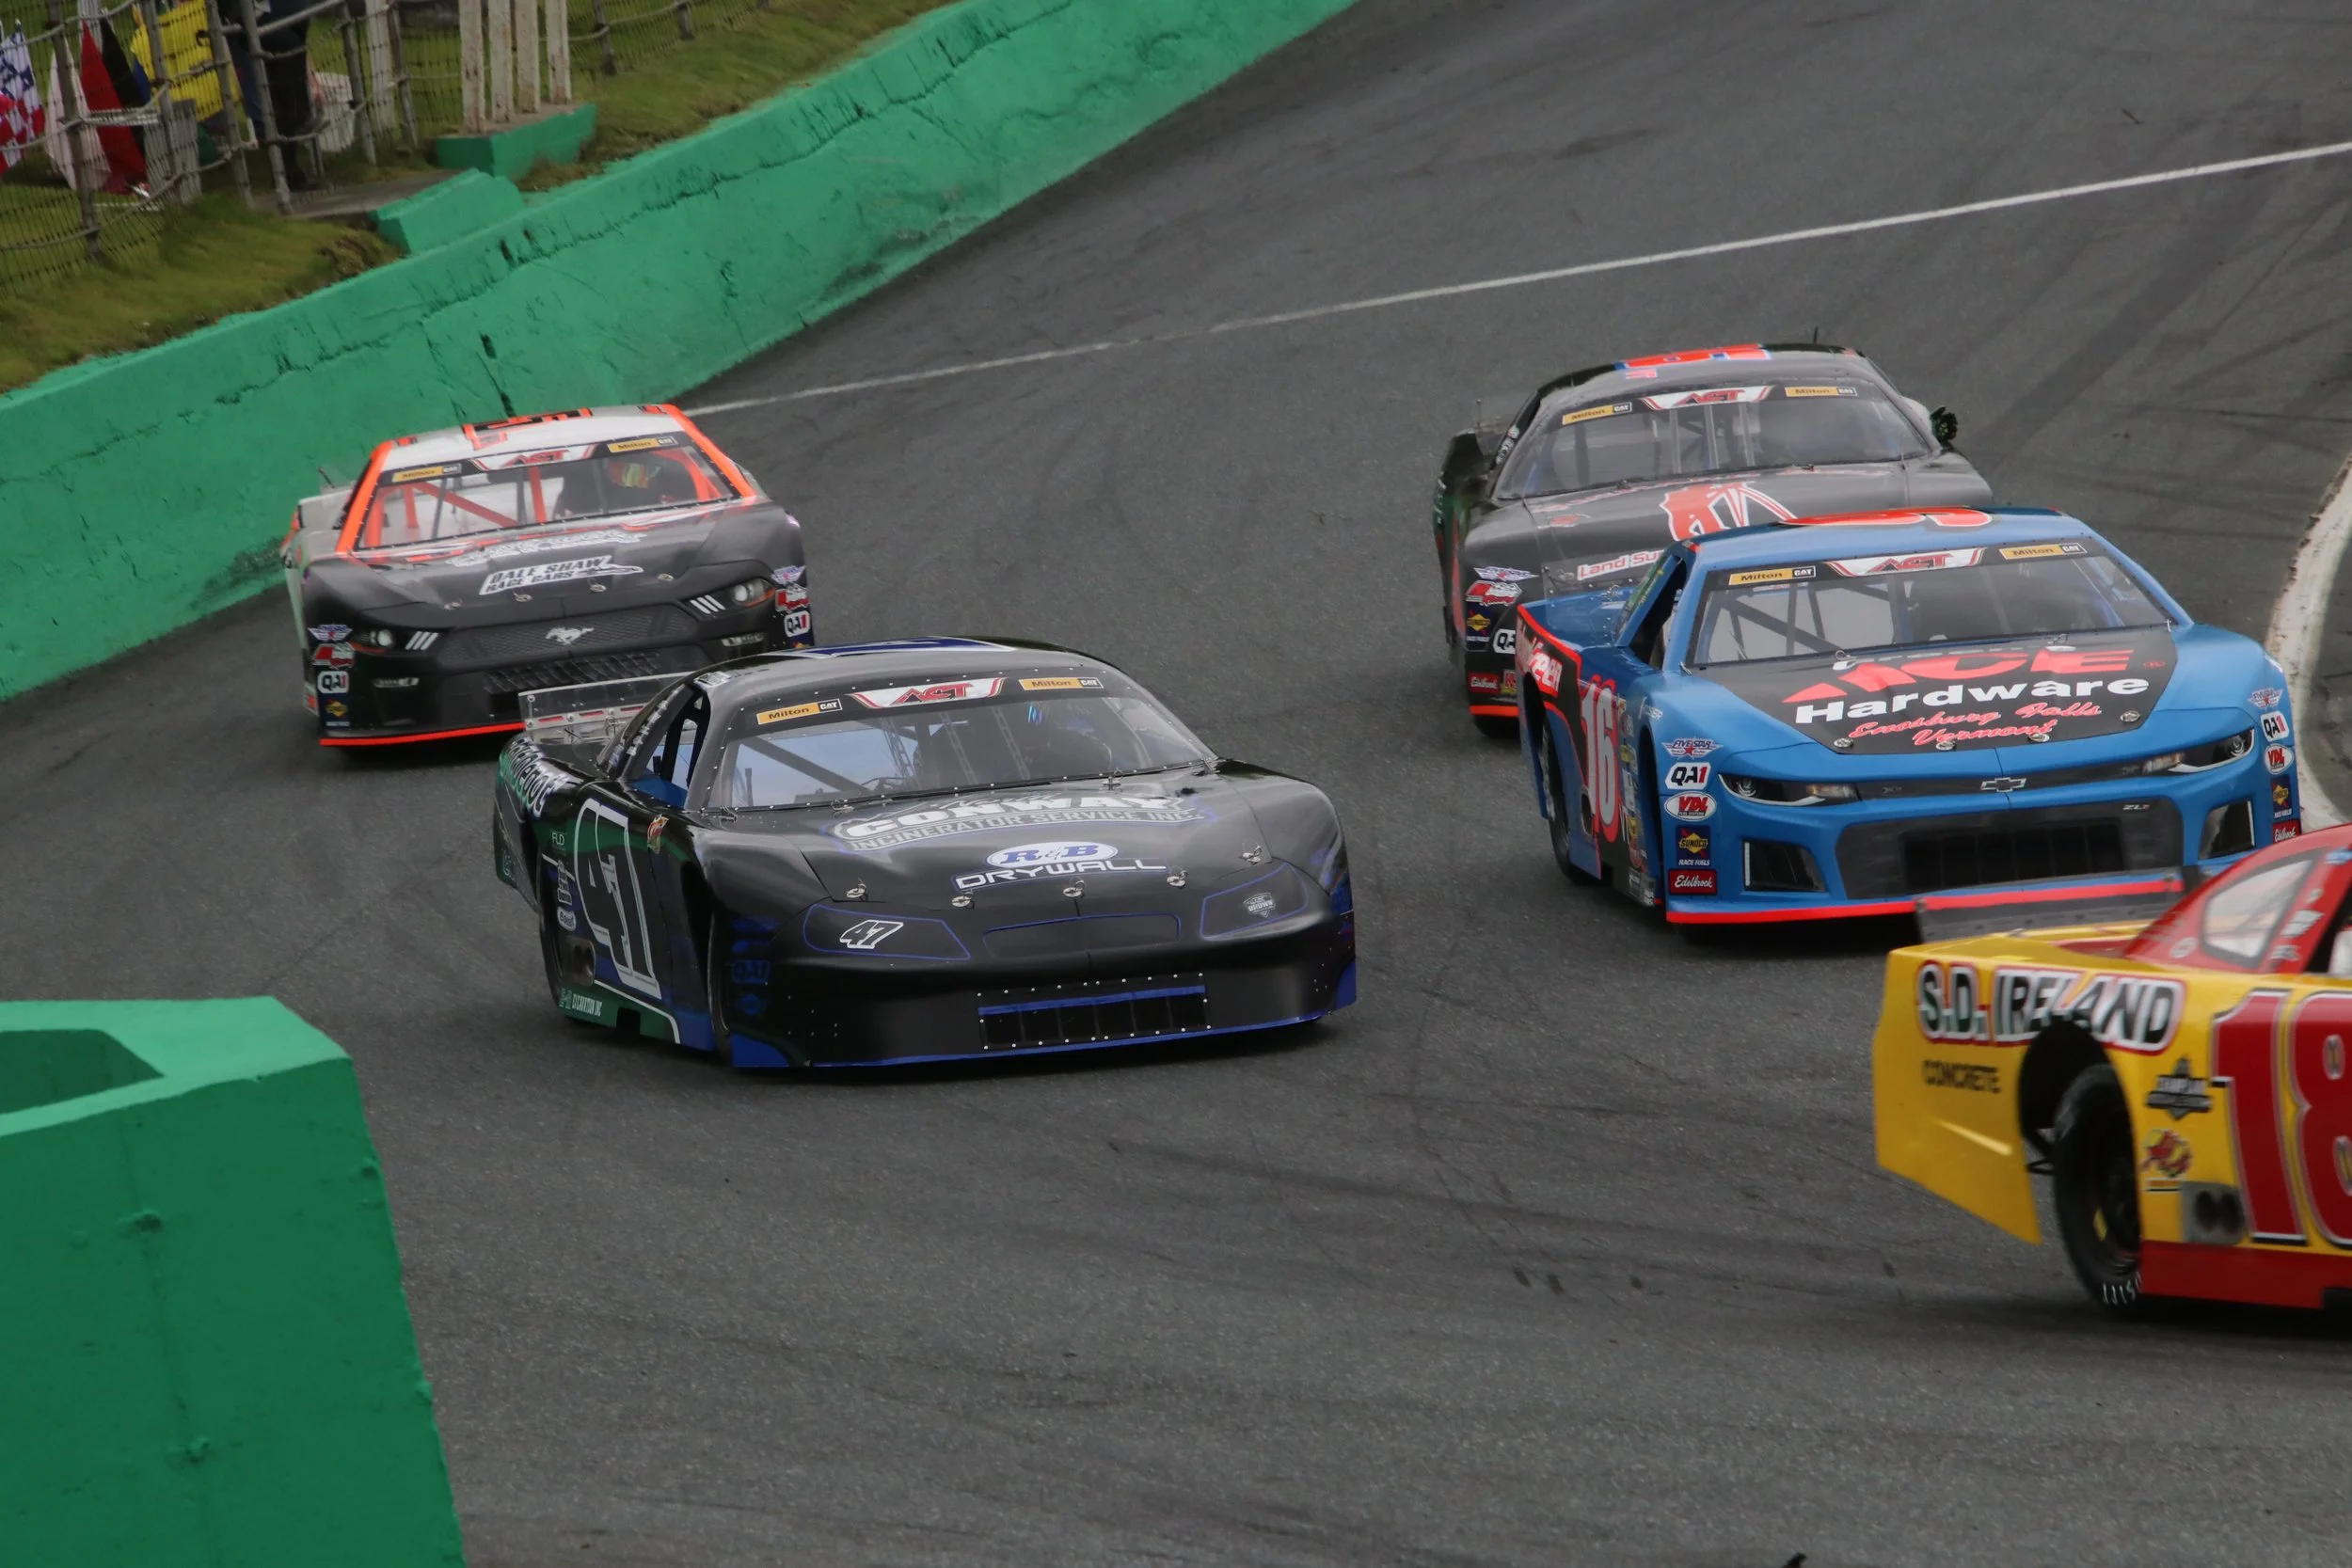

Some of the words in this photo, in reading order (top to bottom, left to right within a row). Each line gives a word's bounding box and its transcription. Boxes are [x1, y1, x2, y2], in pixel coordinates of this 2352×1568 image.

[1867, 552, 1954, 573] ACT
[2011, 546, 2054, 559] Milton
[488, 567, 534, 584] DALE
[544, 557, 607, 574] SHAW
[1580, 557, 1627, 578] Land
[1740, 570, 1784, 582] Milton
[1792, 567, 1814, 578] CAT
[485, 577, 525, 593] RACE
[531, 571, 574, 583] CARS
[1030, 678, 1072, 689] Milton
[1080, 678, 1100, 687] CAT
[1781, 648, 2136, 703] ACE
[890, 683, 973, 705] ACT
[1795, 677, 2150, 725] Hardware
[768, 706, 810, 721] Milton
[819, 700, 838, 712] CAT
[1848, 708, 2002, 739] Enosburg
[2015, 701, 2103, 720] Falls
[1912, 719, 2058, 747] Vermont
[2263, 714, 2286, 738] QA1
[1672, 739, 1692, 749] FIVE
[1693, 739, 1712, 749] STAR
[1581, 675, 1618, 841] 16
[2267, 748, 2285, 765] VDL
[1671, 766, 1708, 786] QA1
[1678, 797, 1708, 813] VDL
[846, 796, 1175, 839] CONWAY
[850, 816, 1022, 850] INCINERATOR
[1036, 809, 1137, 824] SERVICE
[1679, 838, 1708, 848] SUNOCO
[1000, 844, 1100, 865] R&B
[955, 859, 1168, 890] DRYWALL
[1675, 874, 1713, 889] Edelbrock
[573, 798, 661, 999] 47
[839, 919, 903, 949] 47
[1993, 968, 2184, 1052] IRELAND
[1923, 1059, 2001, 1093] CONCRETE
